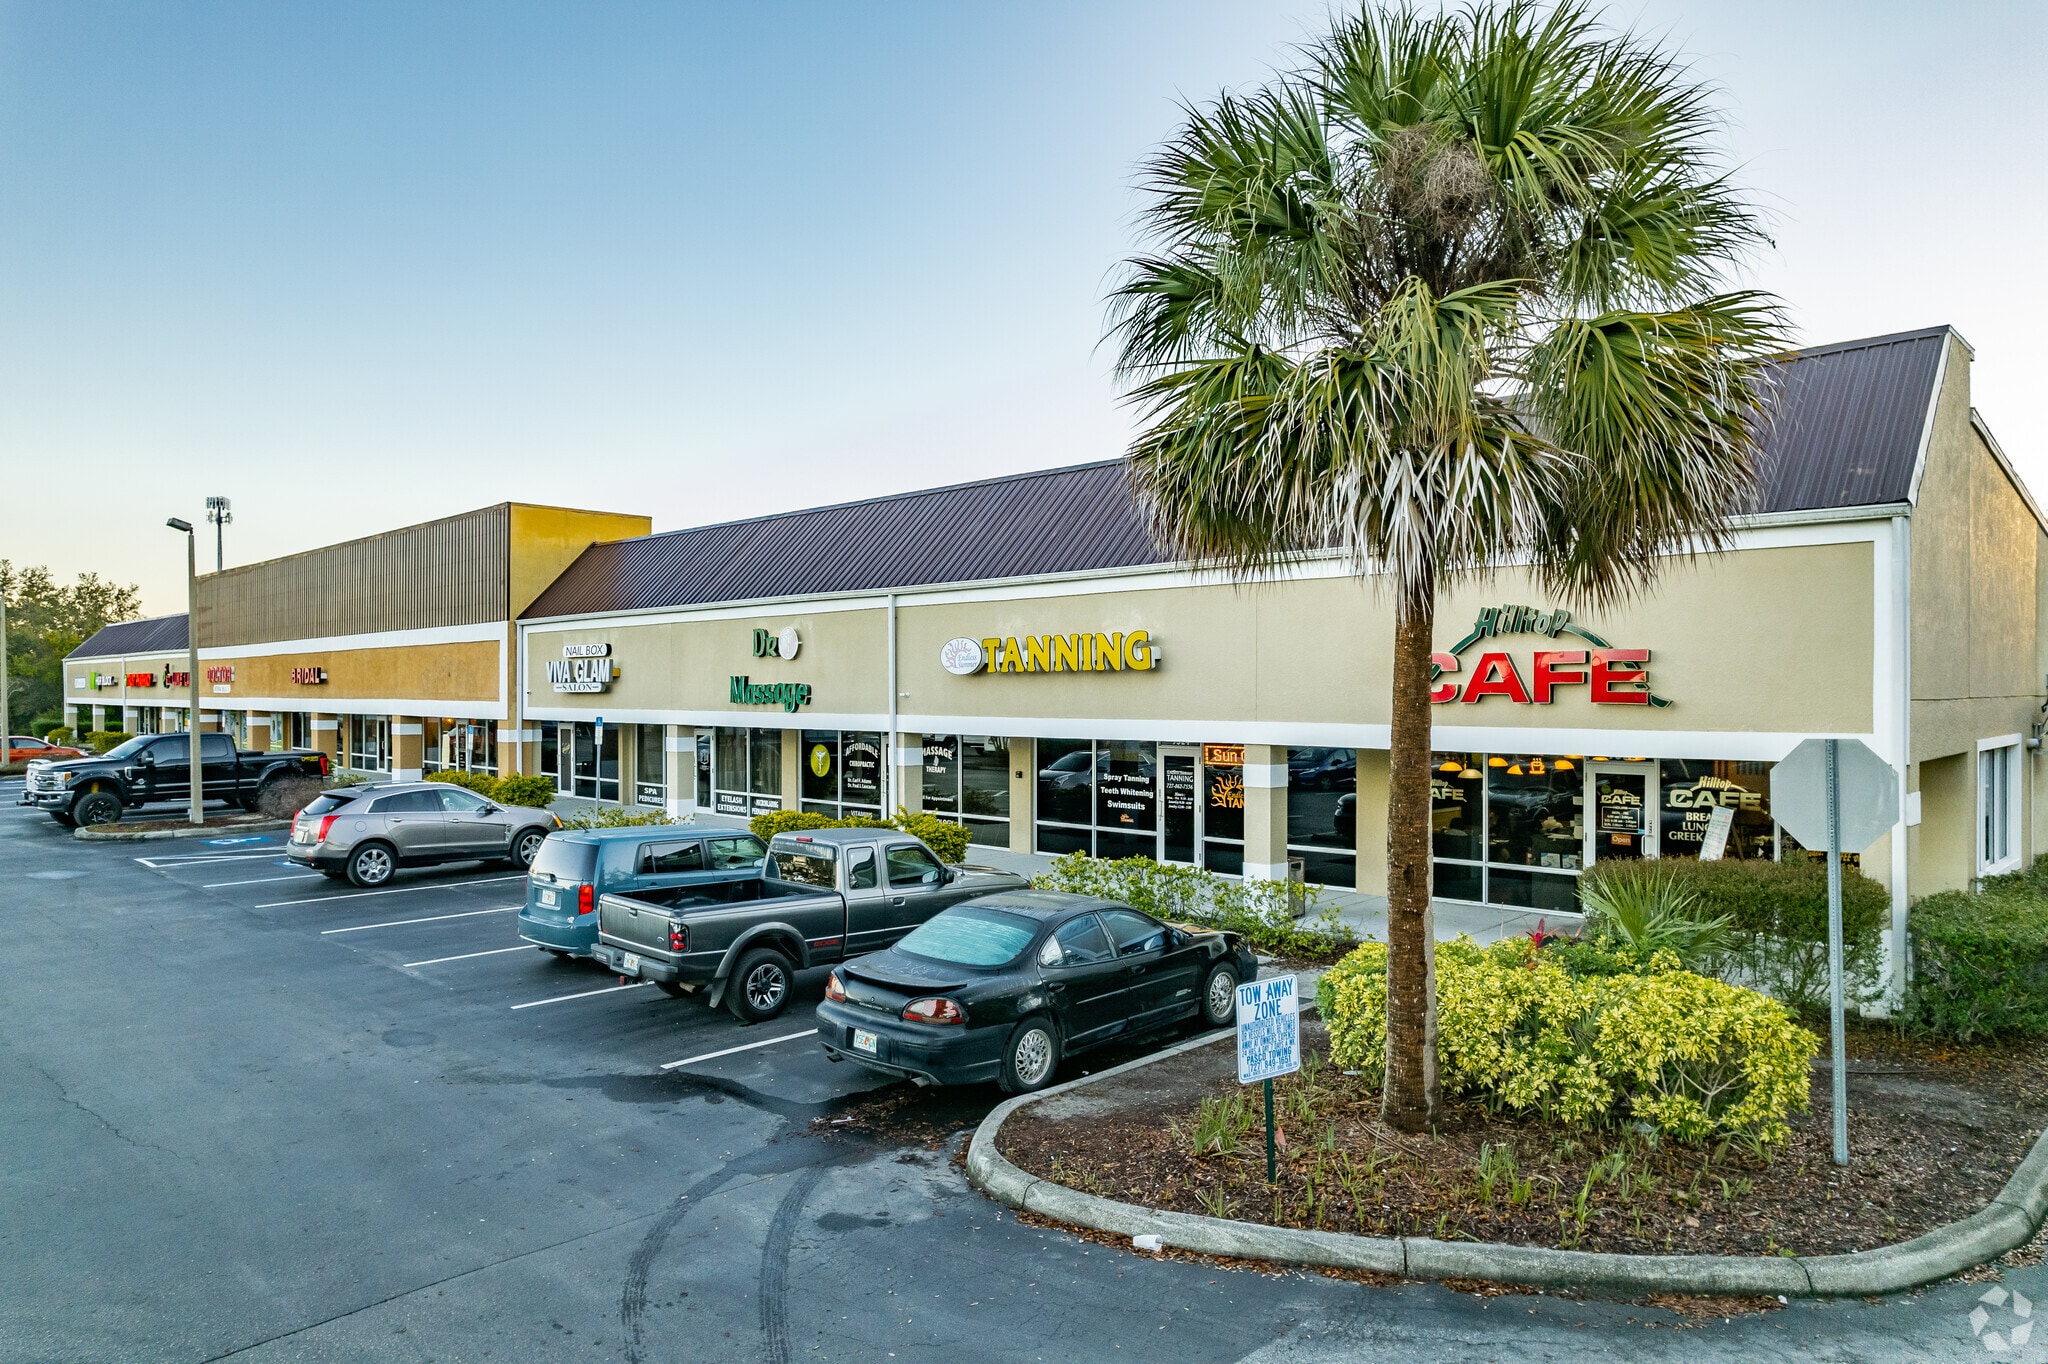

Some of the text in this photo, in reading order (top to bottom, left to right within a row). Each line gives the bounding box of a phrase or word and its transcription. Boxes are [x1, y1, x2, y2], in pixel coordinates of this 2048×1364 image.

[1474, 603, 1571, 638] Hilltop
[565, 644, 604, 656] NAIL BOX
[981, 630, 1153, 673] TANNING
[291, 667, 320, 684] BRIDAL
[546, 658, 612, 683] VIVA GLAM
[1431, 648, 1651, 706] CAFE
[561, 683, 592, 692] SALON
[730, 675, 810, 713] Massage
[845, 743, 879, 759] AFFORDABLE
[1213, 749, 1238, 763] Sun
[1103, 773, 1150, 784] Spray Tanning
[1166, 774, 1194, 782] TANNING
[1699, 776, 1732, 791] Hilltop
[644, 787, 657, 795] SPA
[1100, 786, 1154, 799] Teeth Whitening
[1430, 788, 1464, 800] AFE
[638, 795, 664, 804] PEDICURES
[721, 794, 743, 805] EYELASH
[1107, 800, 1146, 810] Swimsuits
[1601, 794, 1641, 805] CAFE
[1669, 789, 1762, 811] CAFE
[717, 804, 747, 813] EXTENSIONS
[1611, 835, 1631, 843] Open
[1668, 830, 1704, 841] GREEK
[1240, 978, 1293, 1006] TOW AWAY
[1254, 998, 1281, 1020] ZONE
[1247, 1046, 1291, 1064] PASCO TOWING
